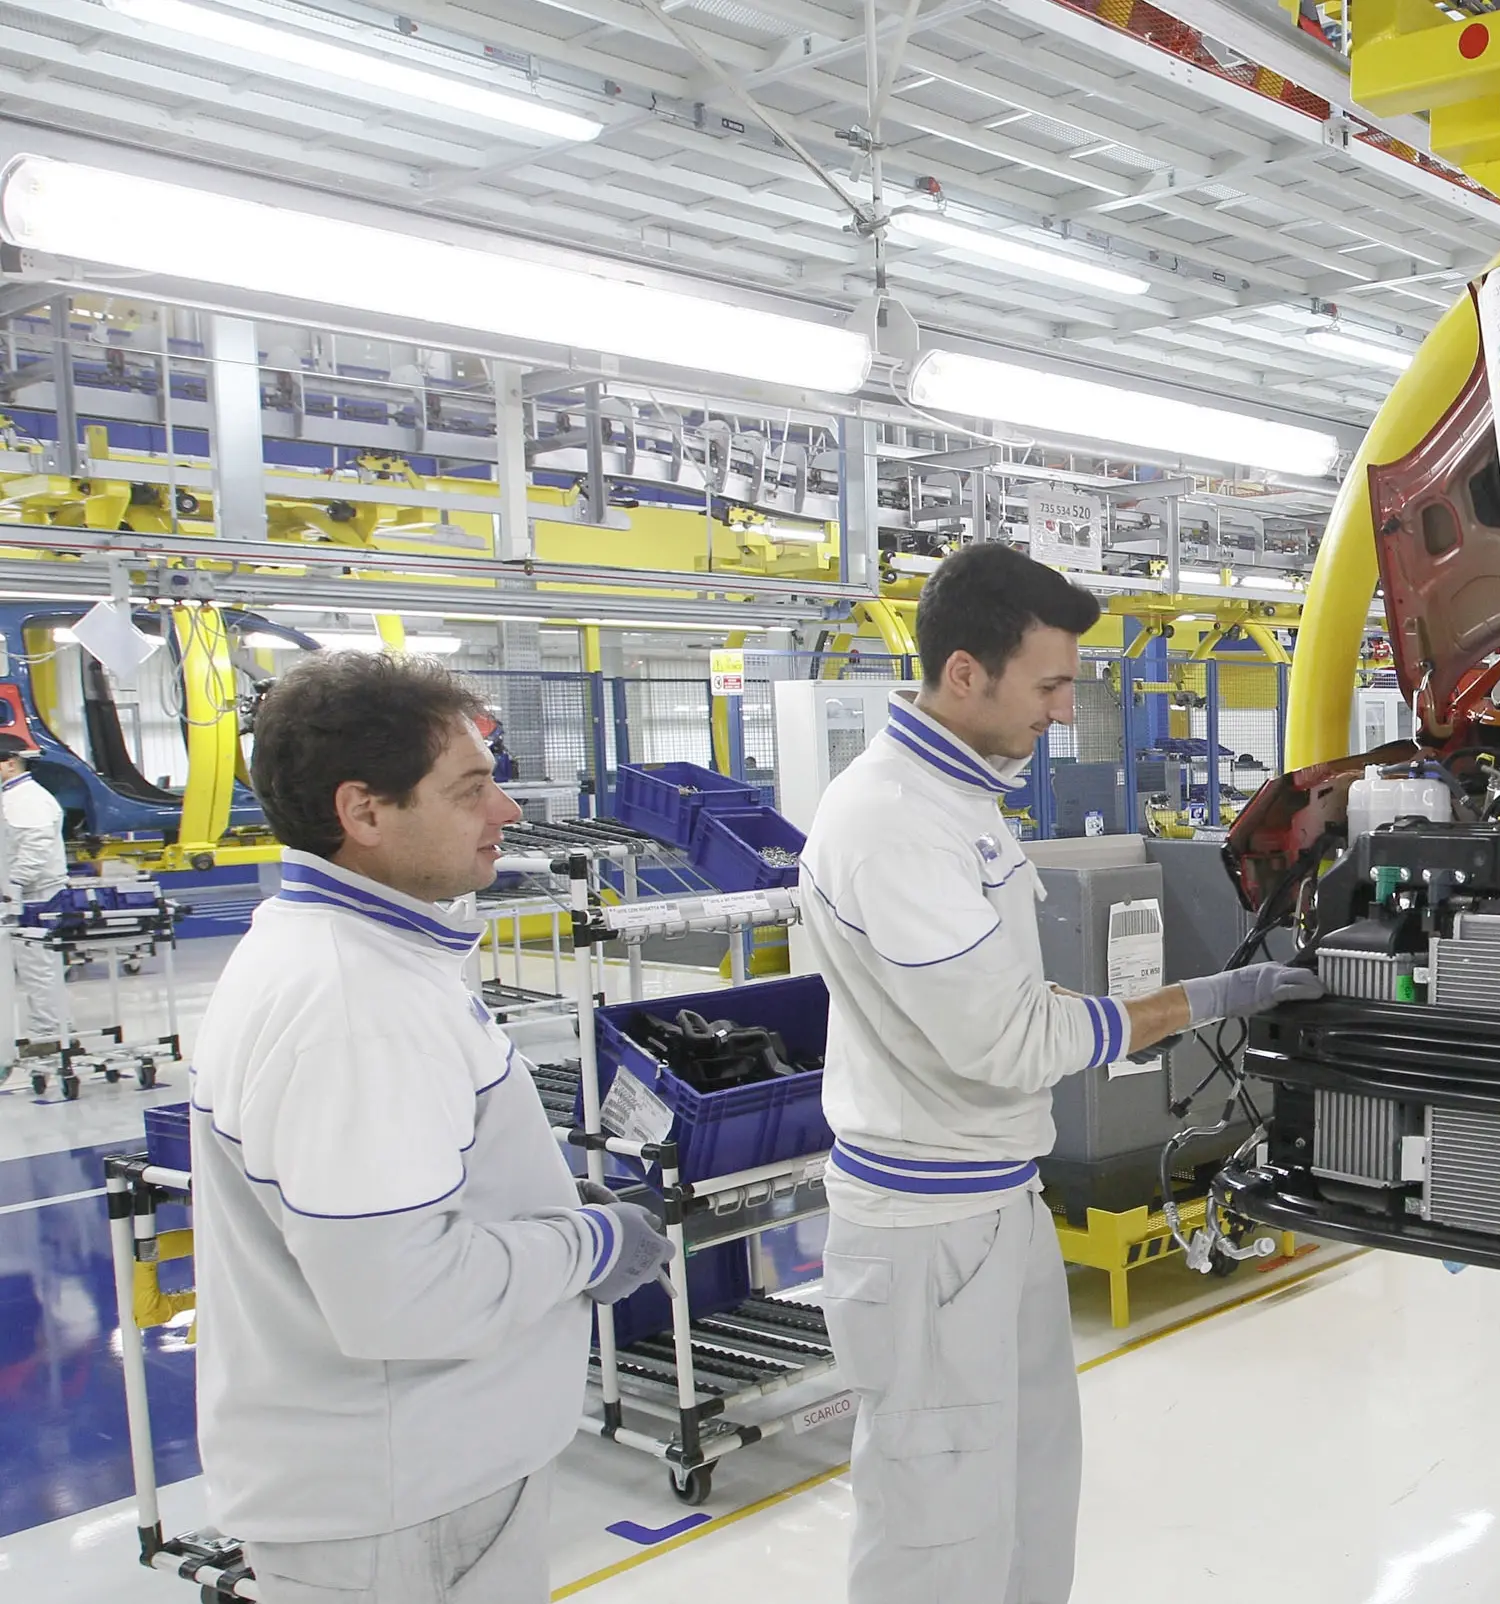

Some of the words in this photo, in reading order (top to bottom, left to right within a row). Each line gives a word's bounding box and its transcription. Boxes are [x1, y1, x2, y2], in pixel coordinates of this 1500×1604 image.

[1040, 503, 1055, 514] 735
[1056, 506, 1071, 516] 534
[1072, 505, 1091, 520] 520
[804, 1399, 850, 1427] SCARICO
